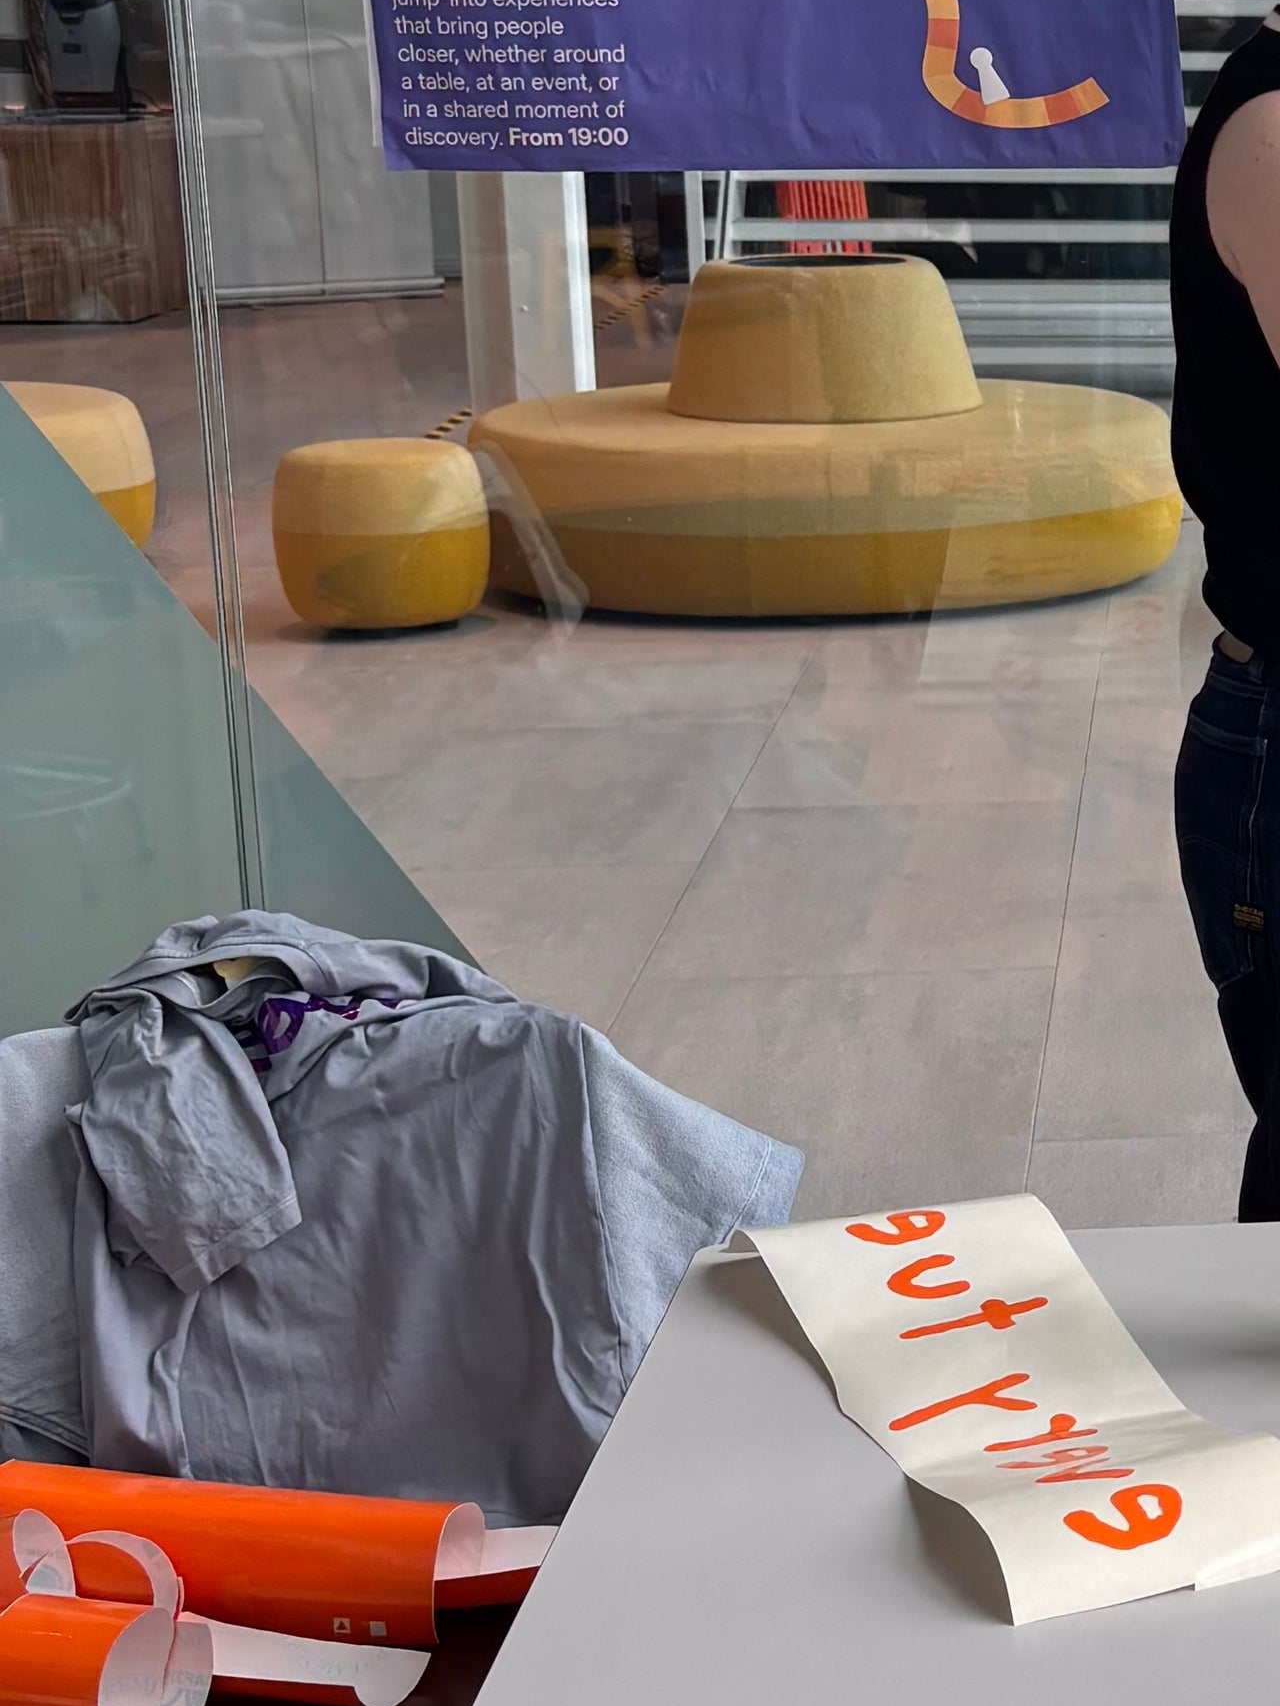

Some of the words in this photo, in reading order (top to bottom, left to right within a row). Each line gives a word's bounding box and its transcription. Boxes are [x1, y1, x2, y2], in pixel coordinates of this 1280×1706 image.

[393, 15, 433, 35] that
[436, 15, 489, 40] bring
[493, 15, 565, 40] people
[397, 42, 459, 66] closer,
[464, 43, 548, 64] whether
[553, 43, 626, 63] around
[401, 76, 413, 90] a
[417, 71, 470, 94] table,
[475, 73, 495, 91] at
[500, 76, 526, 91] an
[531, 73, 593, 94] event,
[598, 76, 620, 91] or
[403, 99, 421, 118] in
[426, 103, 438, 118] a
[443, 99, 509, 119] shared
[514, 100, 600, 119] moment
[605, 99, 625, 119] of
[405, 126, 504, 151] discovery.
[508, 127, 564, 147] From
[567, 126, 629, 146] 19:00
